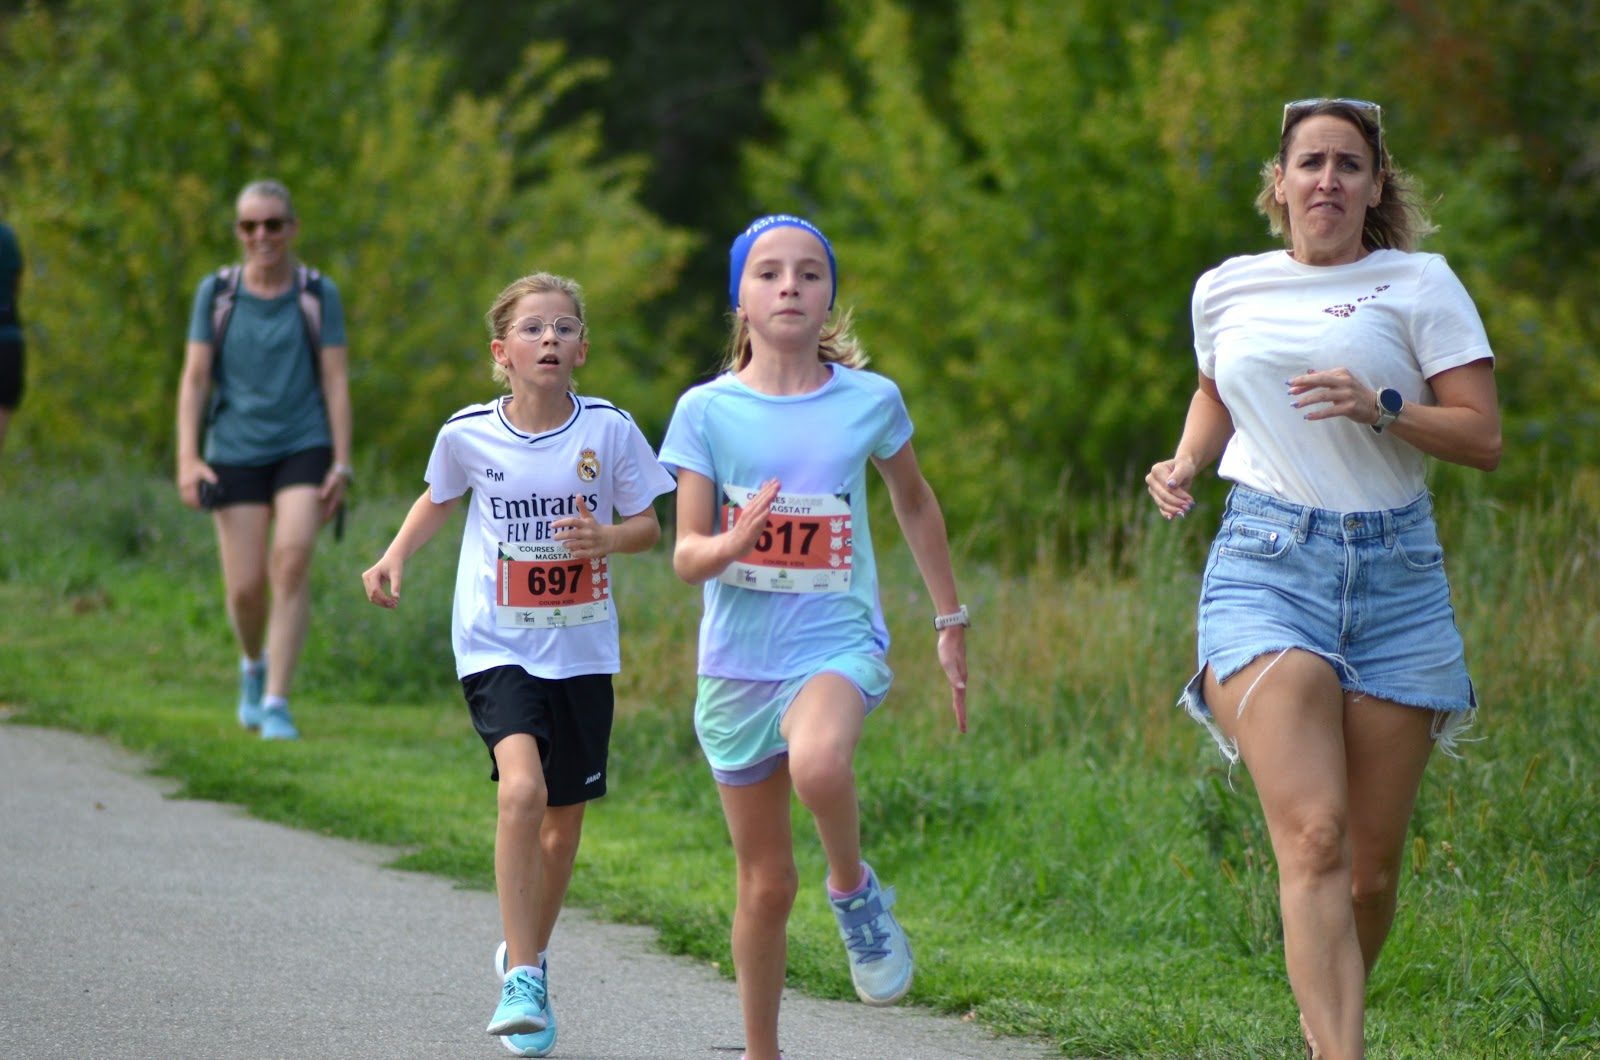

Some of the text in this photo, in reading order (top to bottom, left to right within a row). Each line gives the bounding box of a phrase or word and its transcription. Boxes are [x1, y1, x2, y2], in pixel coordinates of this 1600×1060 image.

[486, 468, 504, 481] RM
[770, 505, 811, 514] AGSTATT
[507, 522, 529, 542] FLY
[755, 520, 820, 555] 617
[519, 545, 555, 553] COURSES
[528, 565, 584, 596] 697
